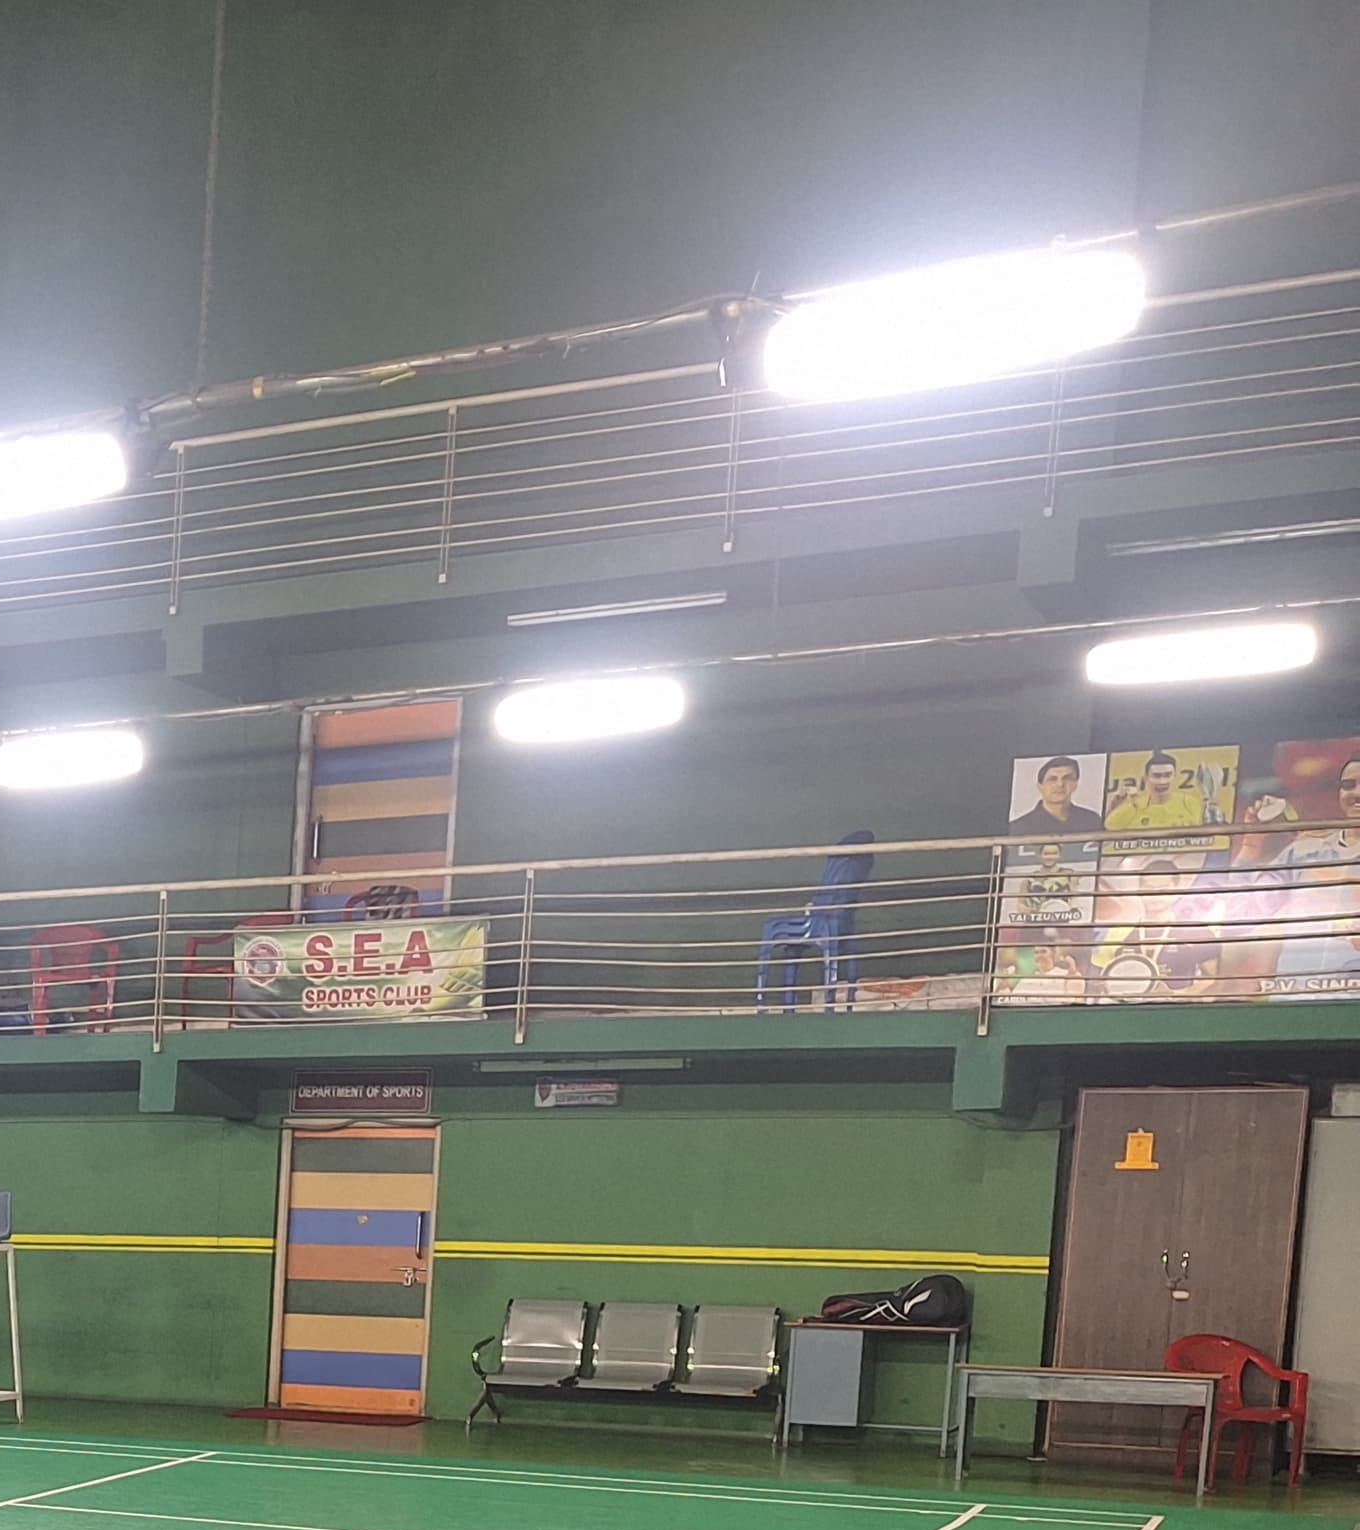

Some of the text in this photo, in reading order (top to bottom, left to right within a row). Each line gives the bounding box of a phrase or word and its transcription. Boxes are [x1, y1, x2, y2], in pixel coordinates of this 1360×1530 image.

[1114, 839, 1137, 849] LEE
[305, 930, 434, 977] S.E.A
[304, 984, 433, 1009] SPORTS CLUB
[298, 1084, 424, 1098] DEPARTMENT OF SPORTS
